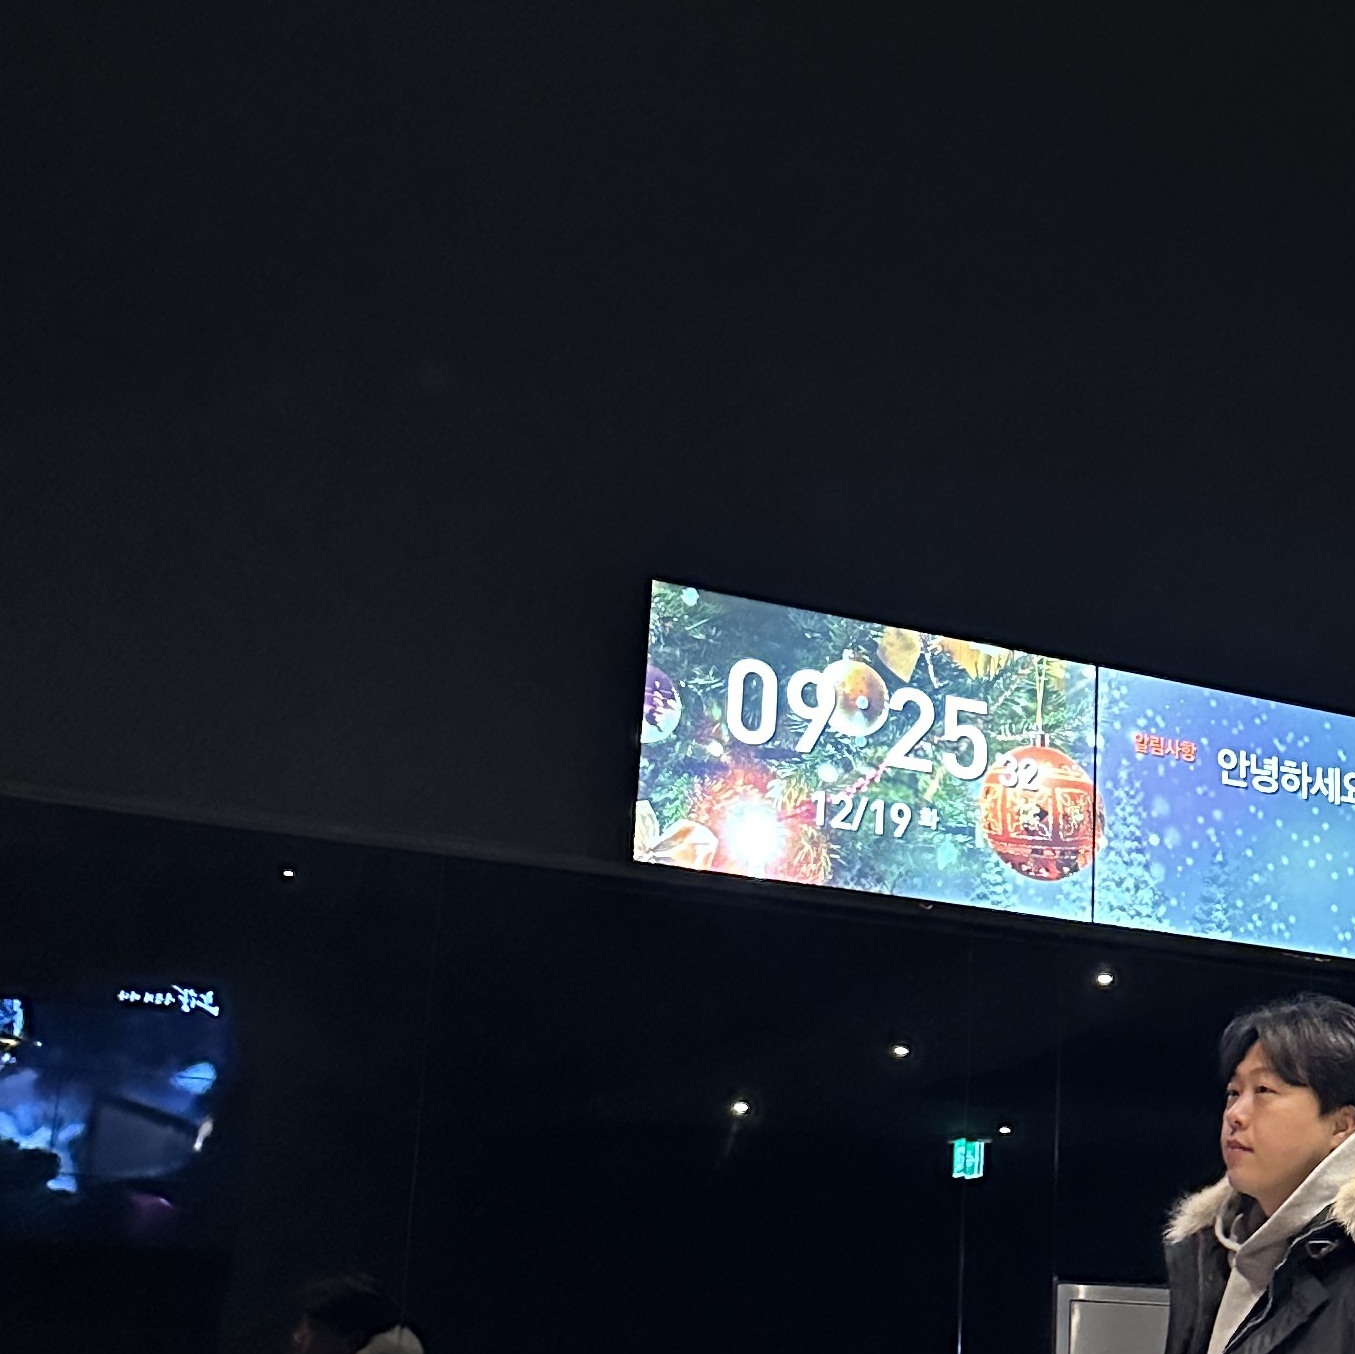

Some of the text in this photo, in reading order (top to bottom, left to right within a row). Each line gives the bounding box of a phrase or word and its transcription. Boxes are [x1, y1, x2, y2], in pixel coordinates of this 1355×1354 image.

[1134, 733, 1197, 763] 알림사항
[999, 754, 1039, 792] 32
[811, 790, 912, 838] 12/19
